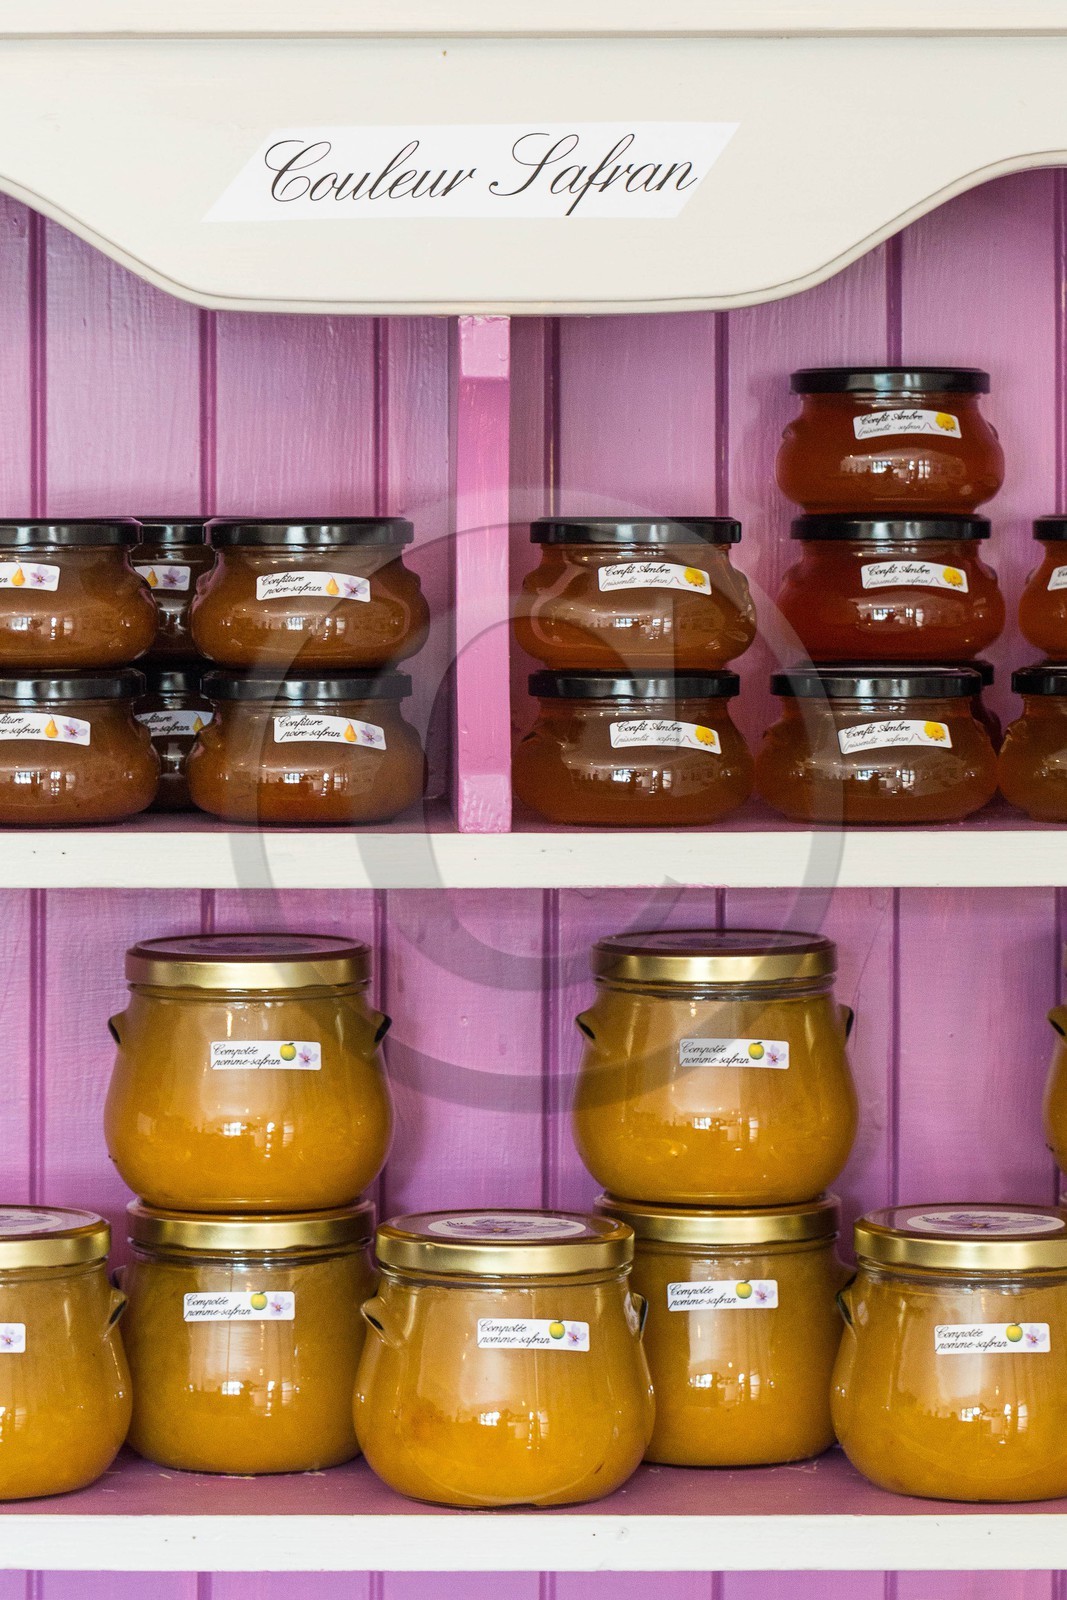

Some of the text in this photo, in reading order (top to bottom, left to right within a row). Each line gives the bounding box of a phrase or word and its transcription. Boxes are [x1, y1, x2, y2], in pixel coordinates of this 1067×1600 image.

[264, 132, 698, 217] Couleur Safran
[860, 410, 923, 425] Confit Ambre
[605, 563, 671, 576] Confit Ambre
[868, 563, 931, 576] Confit Ambre
[261, 573, 305, 588] Confiture
[264, 579, 323, 598] poire-safran
[277, 714, 324, 730] Confiture
[616, 721, 683, 733] Confit Ambre
[844, 720, 911, 739] Confit Ambre
[280, 725, 341, 740] poire-safran
[213, 1043, 258, 1058] Compotée
[681, 1041, 727, 1056] Compotée
[212, 1054, 281, 1069] pomme-safran
[680, 1052, 749, 1067] pomme-safran
[669, 1283, 714, 1297] Compotée
[186, 1295, 229, 1309] Compotée
[668, 1293, 737, 1309] pomme-safran
[185, 1305, 251, 1319] pomme-safran
[479, 1320, 527, 1335] Compotée
[936, 1326, 983, 1340] Compotée
[478, 1331, 551, 1347] pomme-safran
[935, 1336, 1008, 1352] pomme-safran
